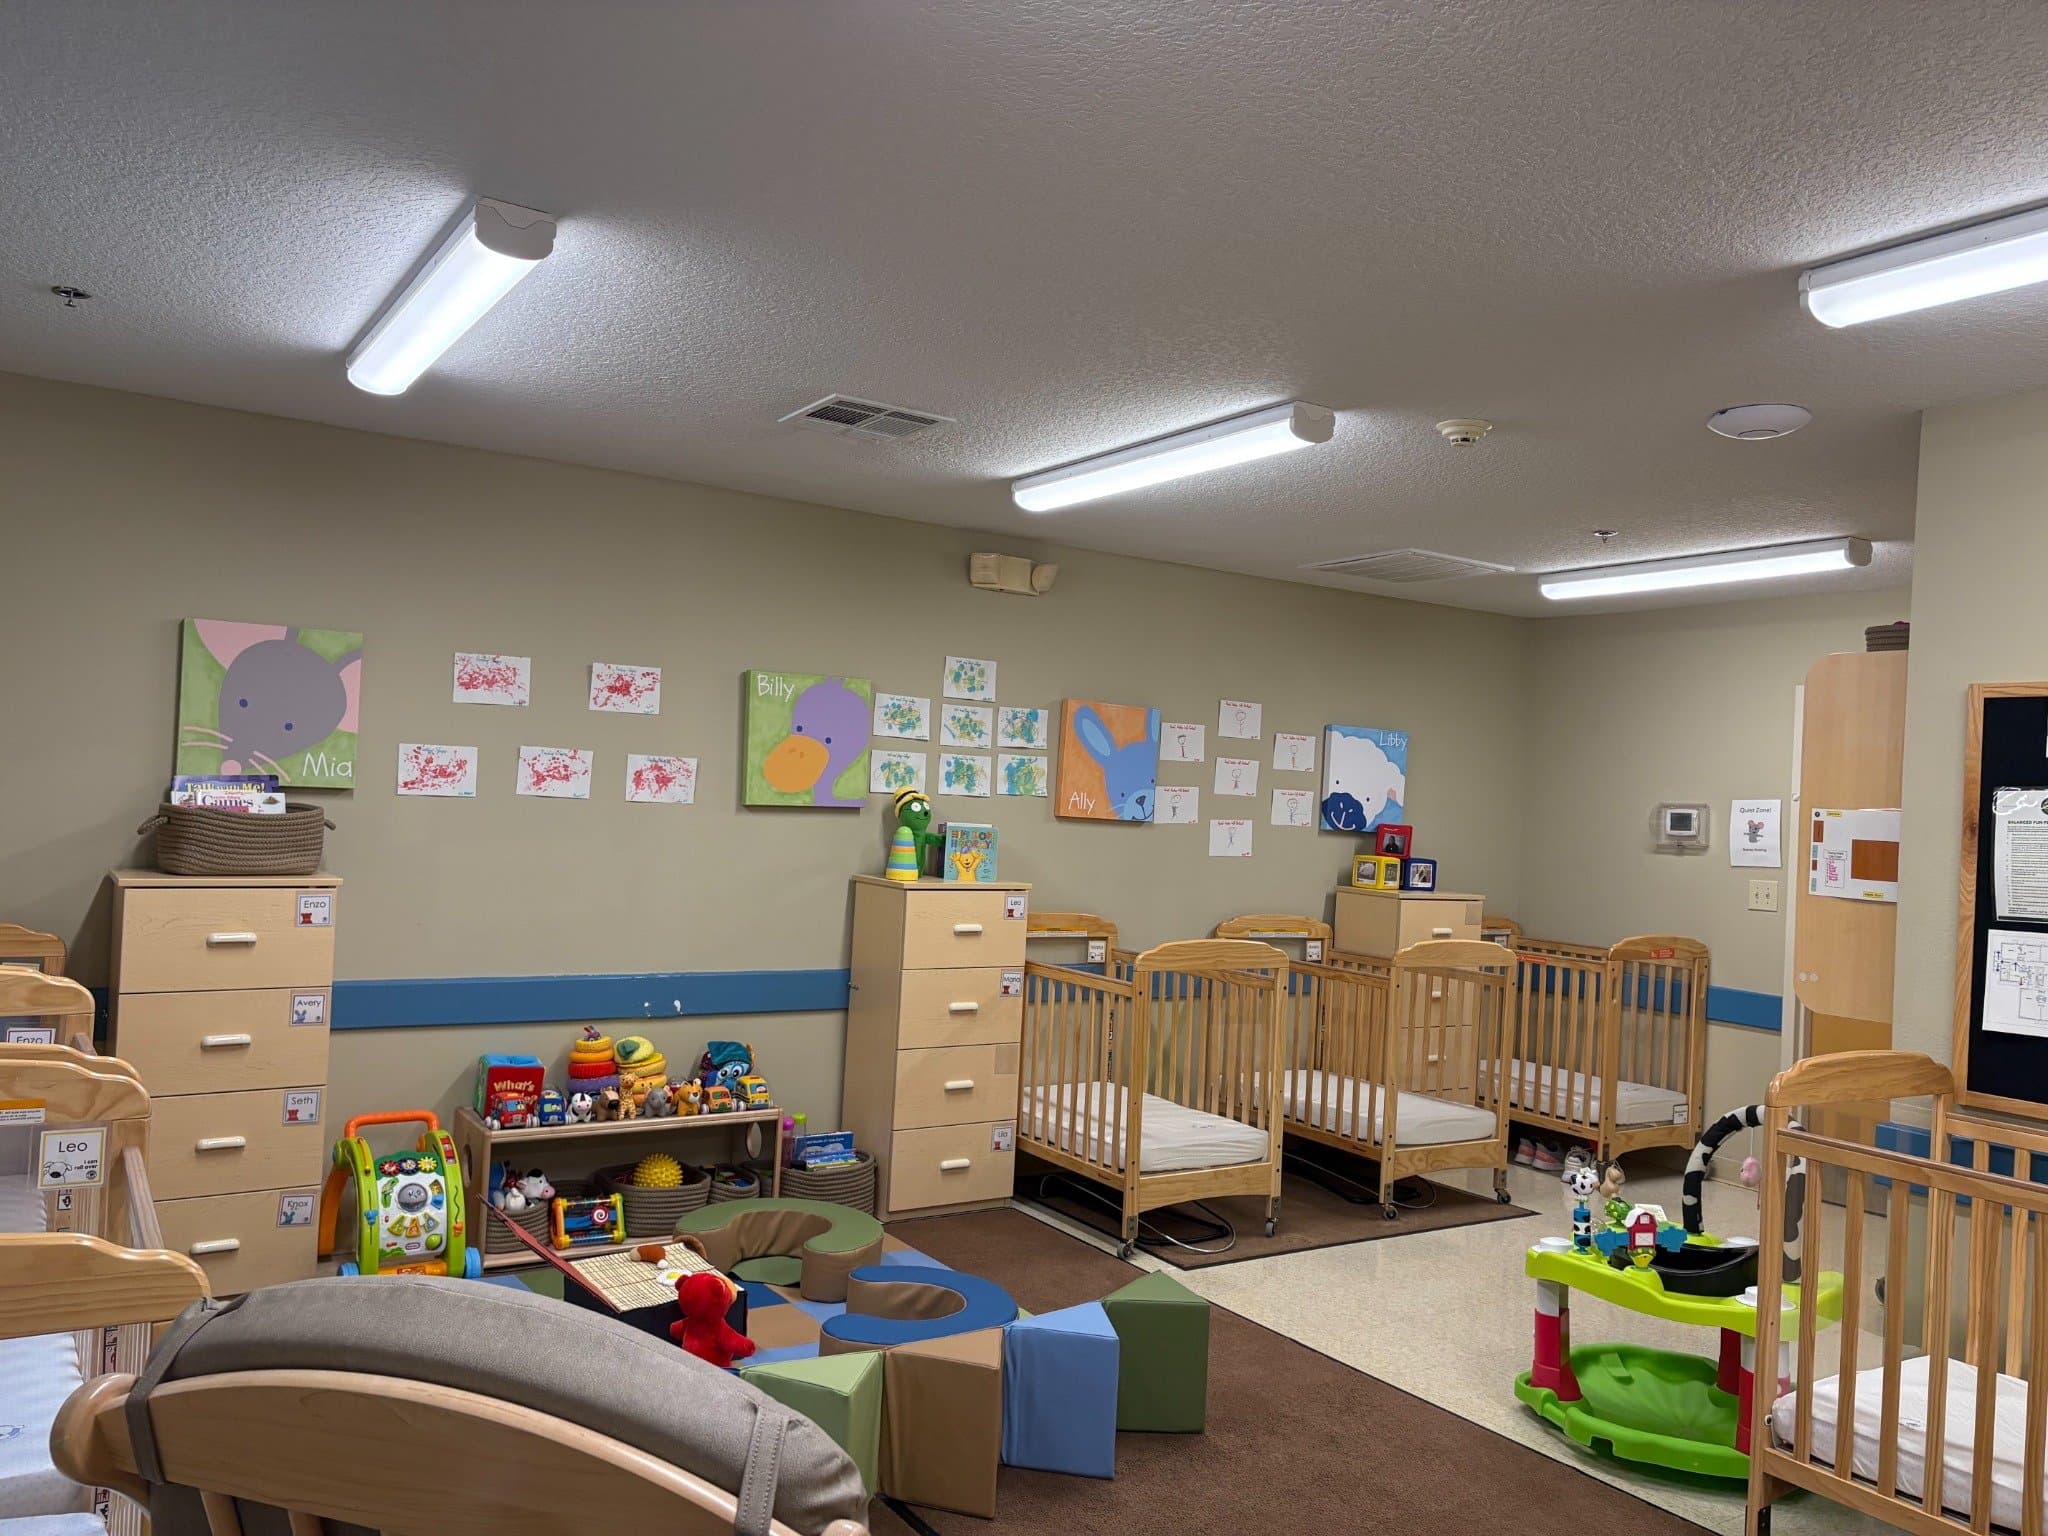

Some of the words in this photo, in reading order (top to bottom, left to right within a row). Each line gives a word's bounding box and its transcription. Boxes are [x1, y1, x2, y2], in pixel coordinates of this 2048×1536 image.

[757, 673, 794, 702] Billy
[1379, 731, 1408, 751] Libby
[302, 752, 352, 777] Mia
[1068, 791, 1096, 815] Ally
[304, 900, 326, 909] Enzo
[297, 999, 321, 1007] Avery
[493, 1080, 535, 1092] What's
[291, 1096, 313, 1105] Seth
[58, 1141, 88, 1153] Leo
[287, 1200, 308, 1208] Knox
